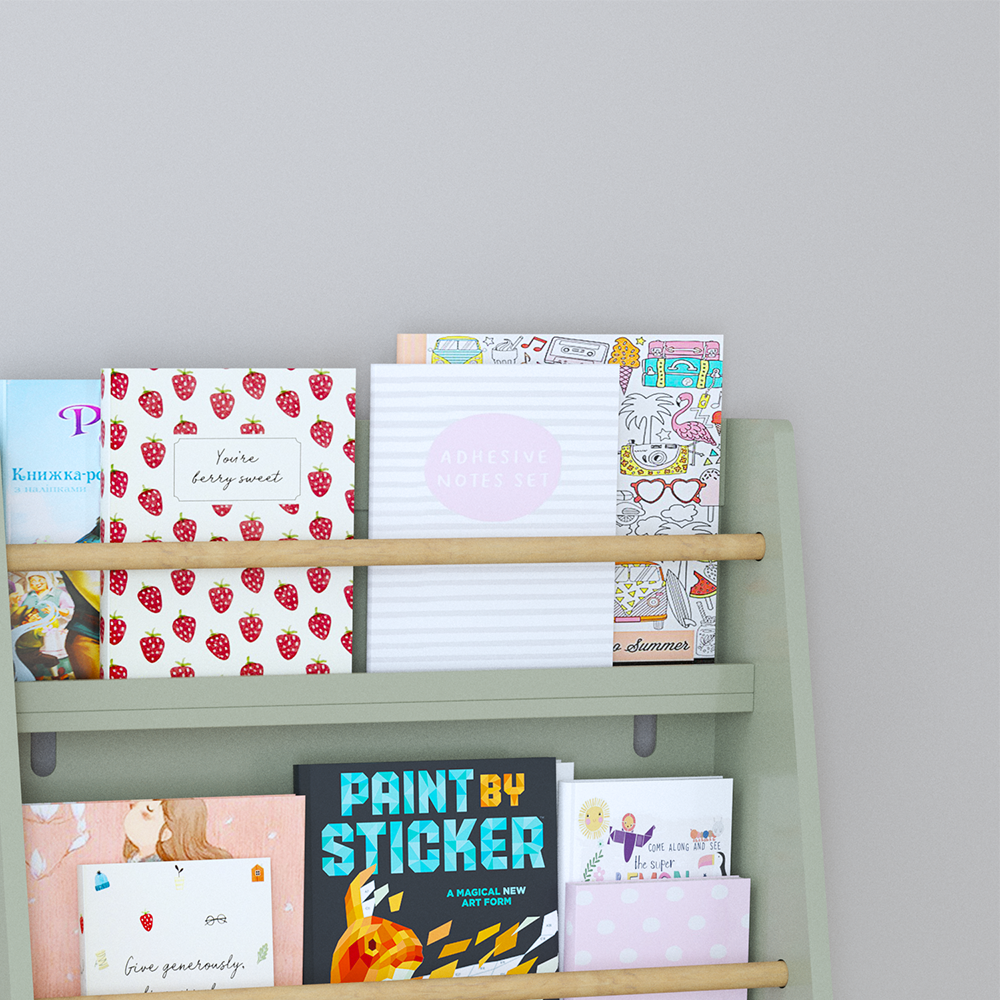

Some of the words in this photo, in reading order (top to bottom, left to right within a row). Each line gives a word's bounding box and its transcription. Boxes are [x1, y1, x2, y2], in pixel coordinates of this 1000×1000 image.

[216, 448, 259, 465] You're
[440, 450, 547, 464] ADHESIVE
[192, 470, 236, 491] berry
[238, 470, 283, 483] sweet
[437, 473, 503, 488] NOTES
[514, 473, 549, 487] SET
[625, 638, 690, 653] Summer
[340, 769, 474, 816] PAINT
[479, 773, 525, 807] BY
[321, 816, 545, 877] STICKER
[648, 843, 665, 852] COME
[668, 842, 690, 852] ALONG
[693, 841, 706, 851] AND
[709, 841, 721, 850] SEE
[634, 855, 648, 870] the
[650, 859, 675, 872] super
[446, 889, 454, 898] A
[456, 888, 500, 897] MAGICAL
[502, 886, 527, 895] NEW
[461, 898, 483, 907] ART
[484, 897, 512, 906] FORM
[124, 956, 159, 976] Give
[162, 954, 245, 979] generously.
